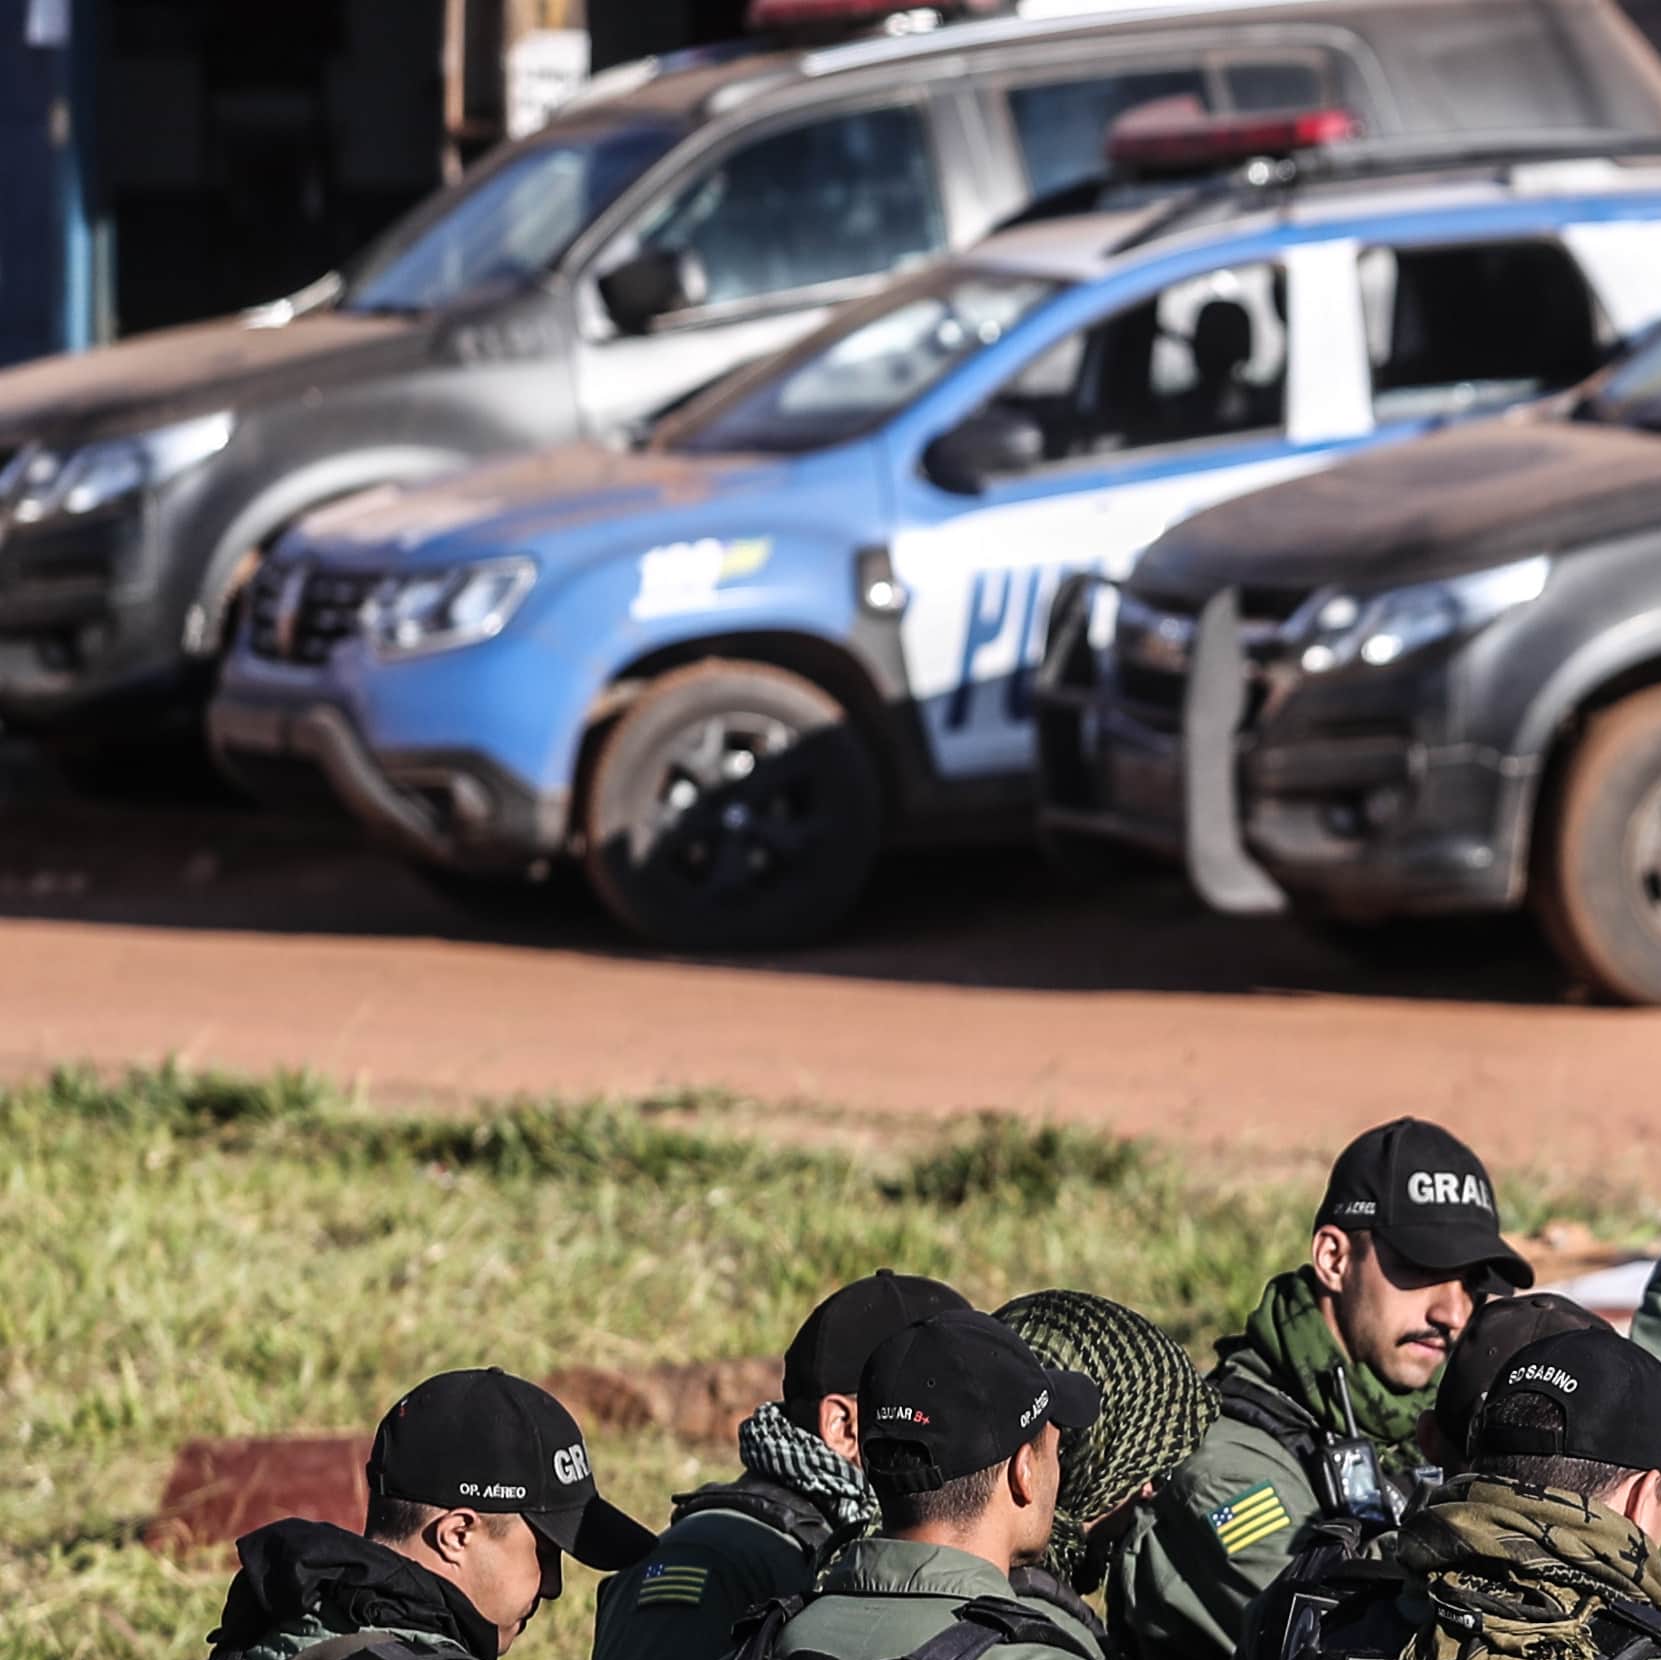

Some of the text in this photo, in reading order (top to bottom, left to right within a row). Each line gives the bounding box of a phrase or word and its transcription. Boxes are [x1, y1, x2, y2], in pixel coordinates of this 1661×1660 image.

[1525, 1364, 1578, 1393] SABINO
[459, 1480, 526, 1499] OP. AÉREO
